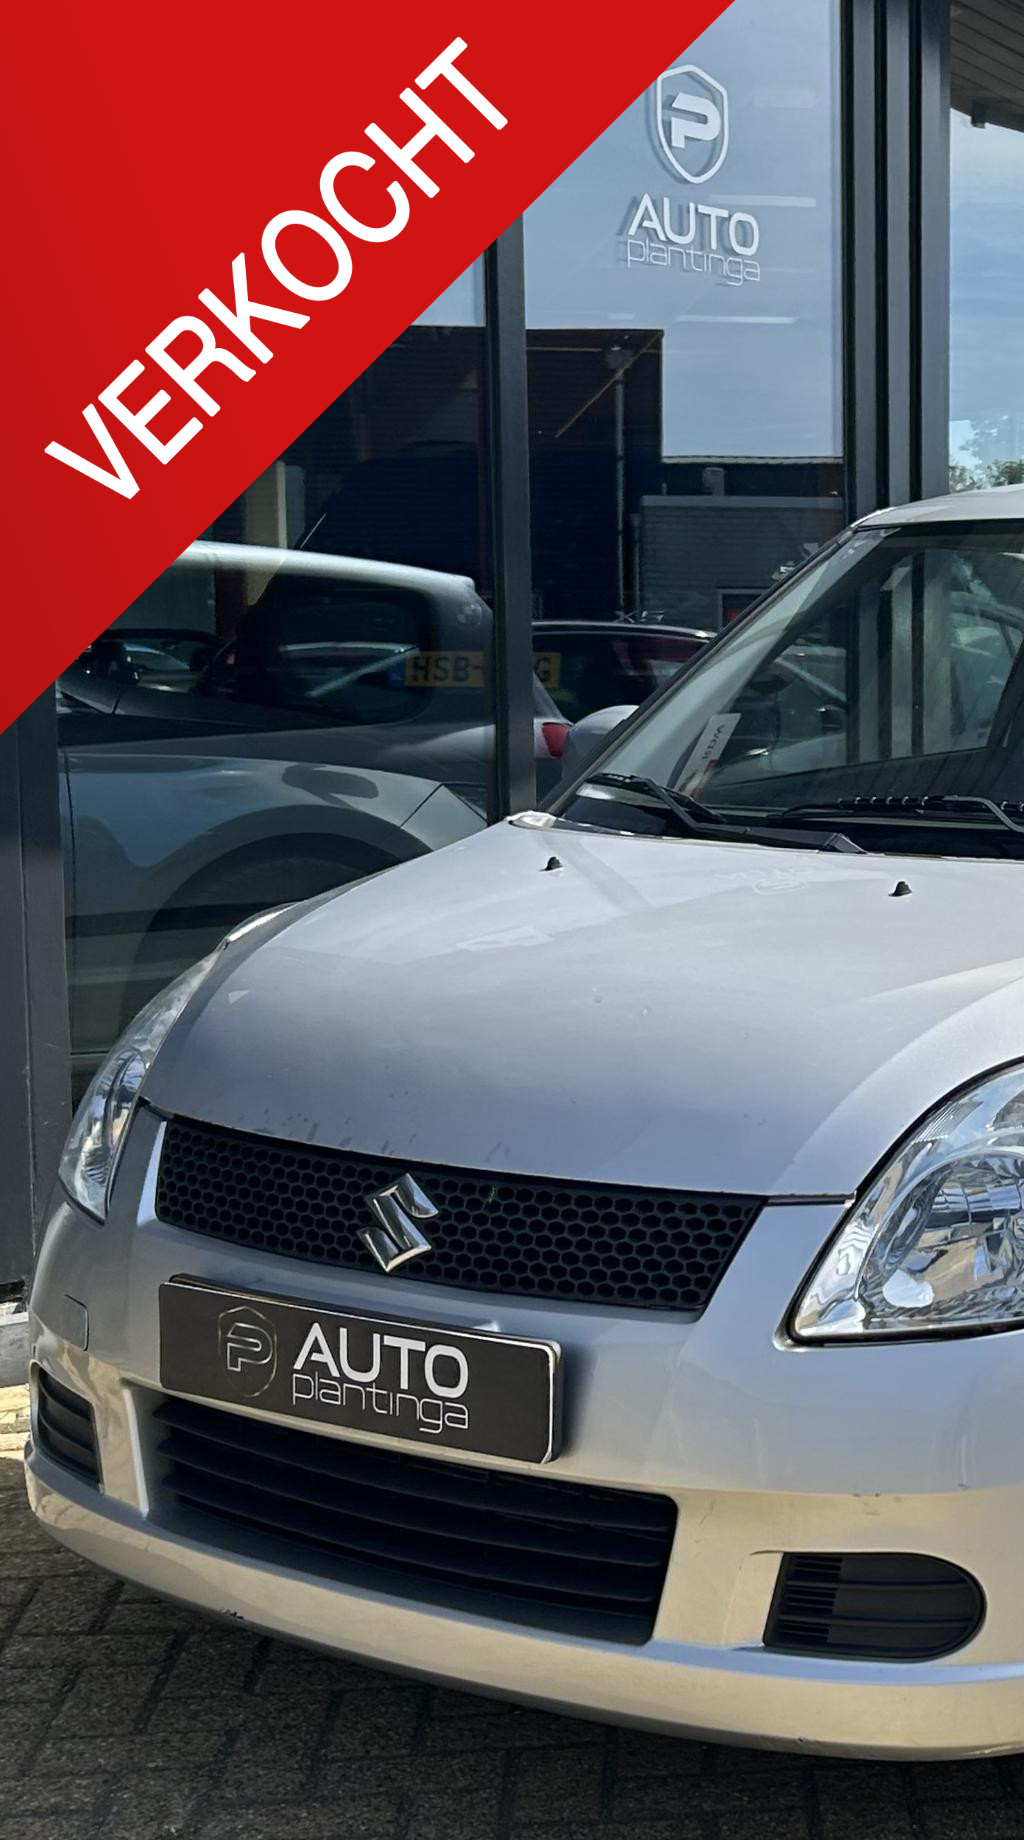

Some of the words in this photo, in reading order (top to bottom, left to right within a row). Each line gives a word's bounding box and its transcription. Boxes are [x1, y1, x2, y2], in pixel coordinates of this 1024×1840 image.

[628, 193, 760, 256] AUTO
[627, 237, 761, 287] plantinga
[292, 1322, 469, 1399] AUTO
[292, 1371, 469, 1434] plantinga
